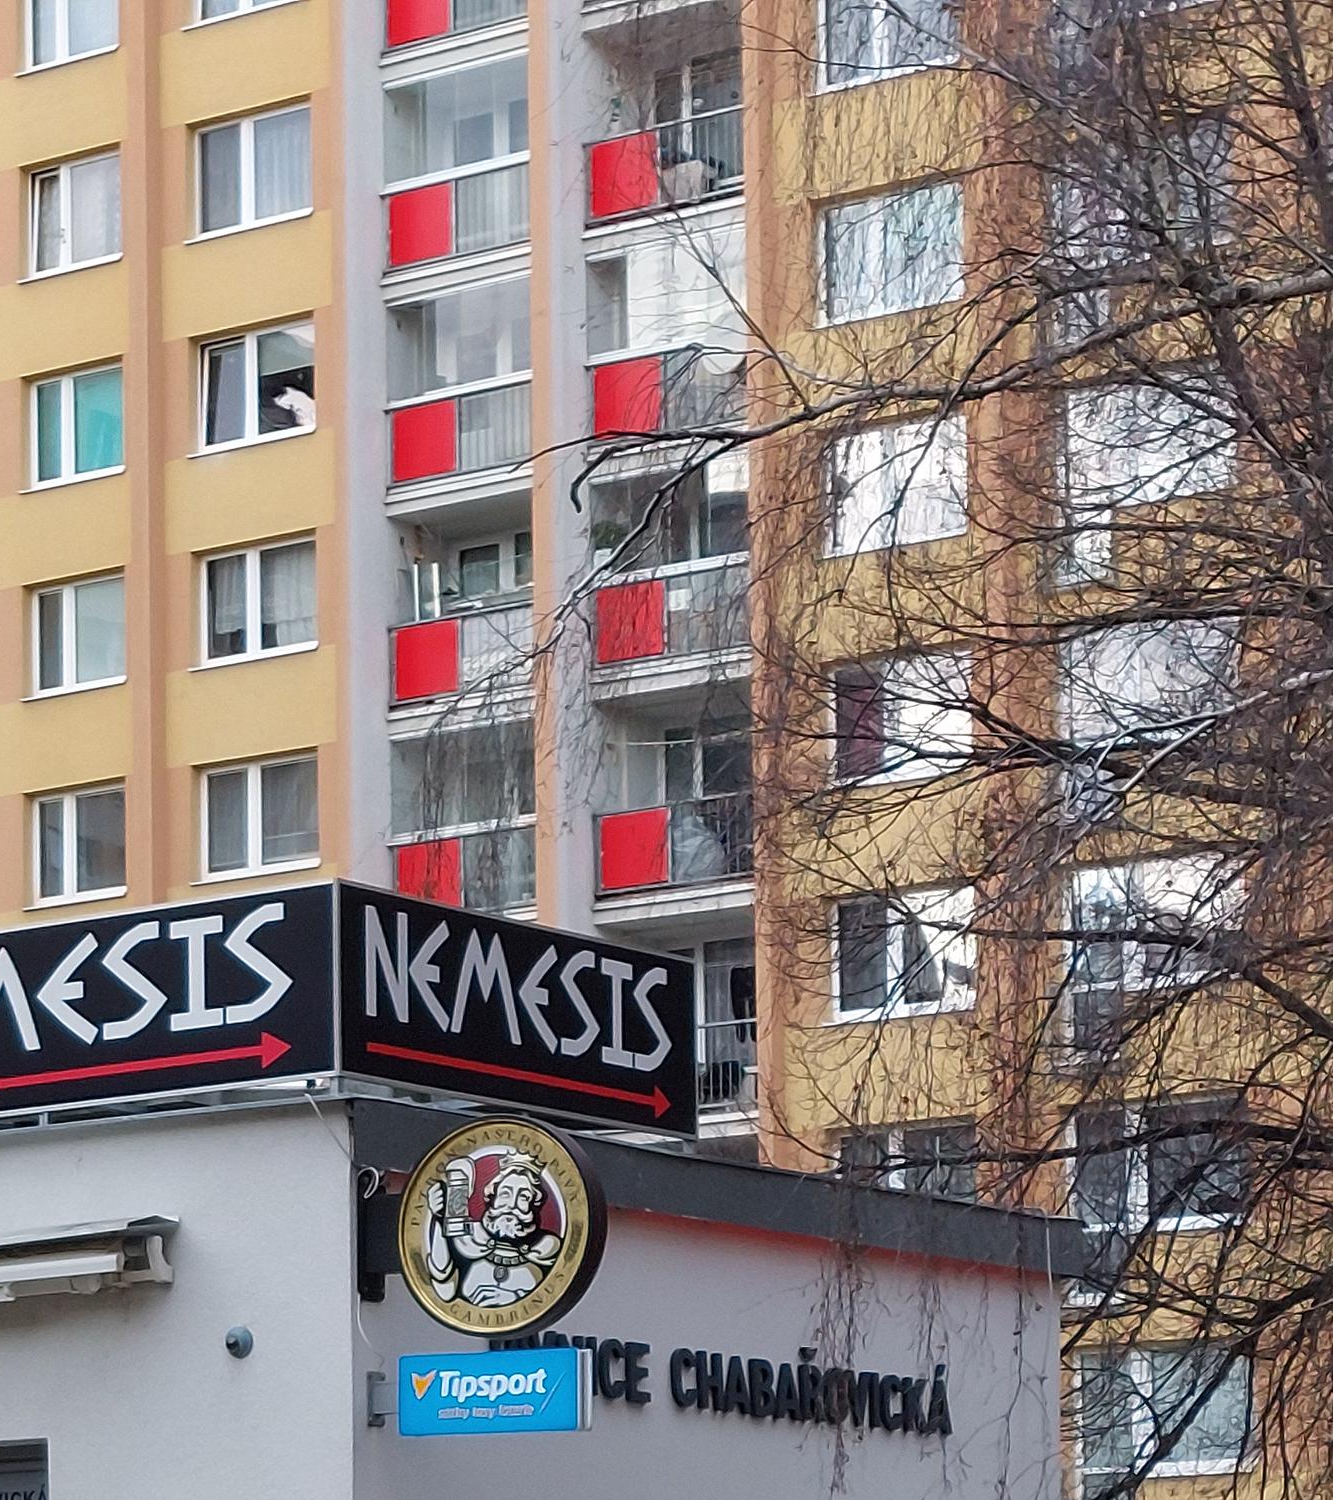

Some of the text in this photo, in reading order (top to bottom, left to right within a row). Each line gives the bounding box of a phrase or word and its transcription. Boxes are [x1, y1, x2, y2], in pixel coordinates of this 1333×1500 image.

[363, 904, 673, 1073] NEMESIS
[450, 1271, 564, 1326] GAMBRINUS
[439, 1369, 547, 1403] Tipsport
